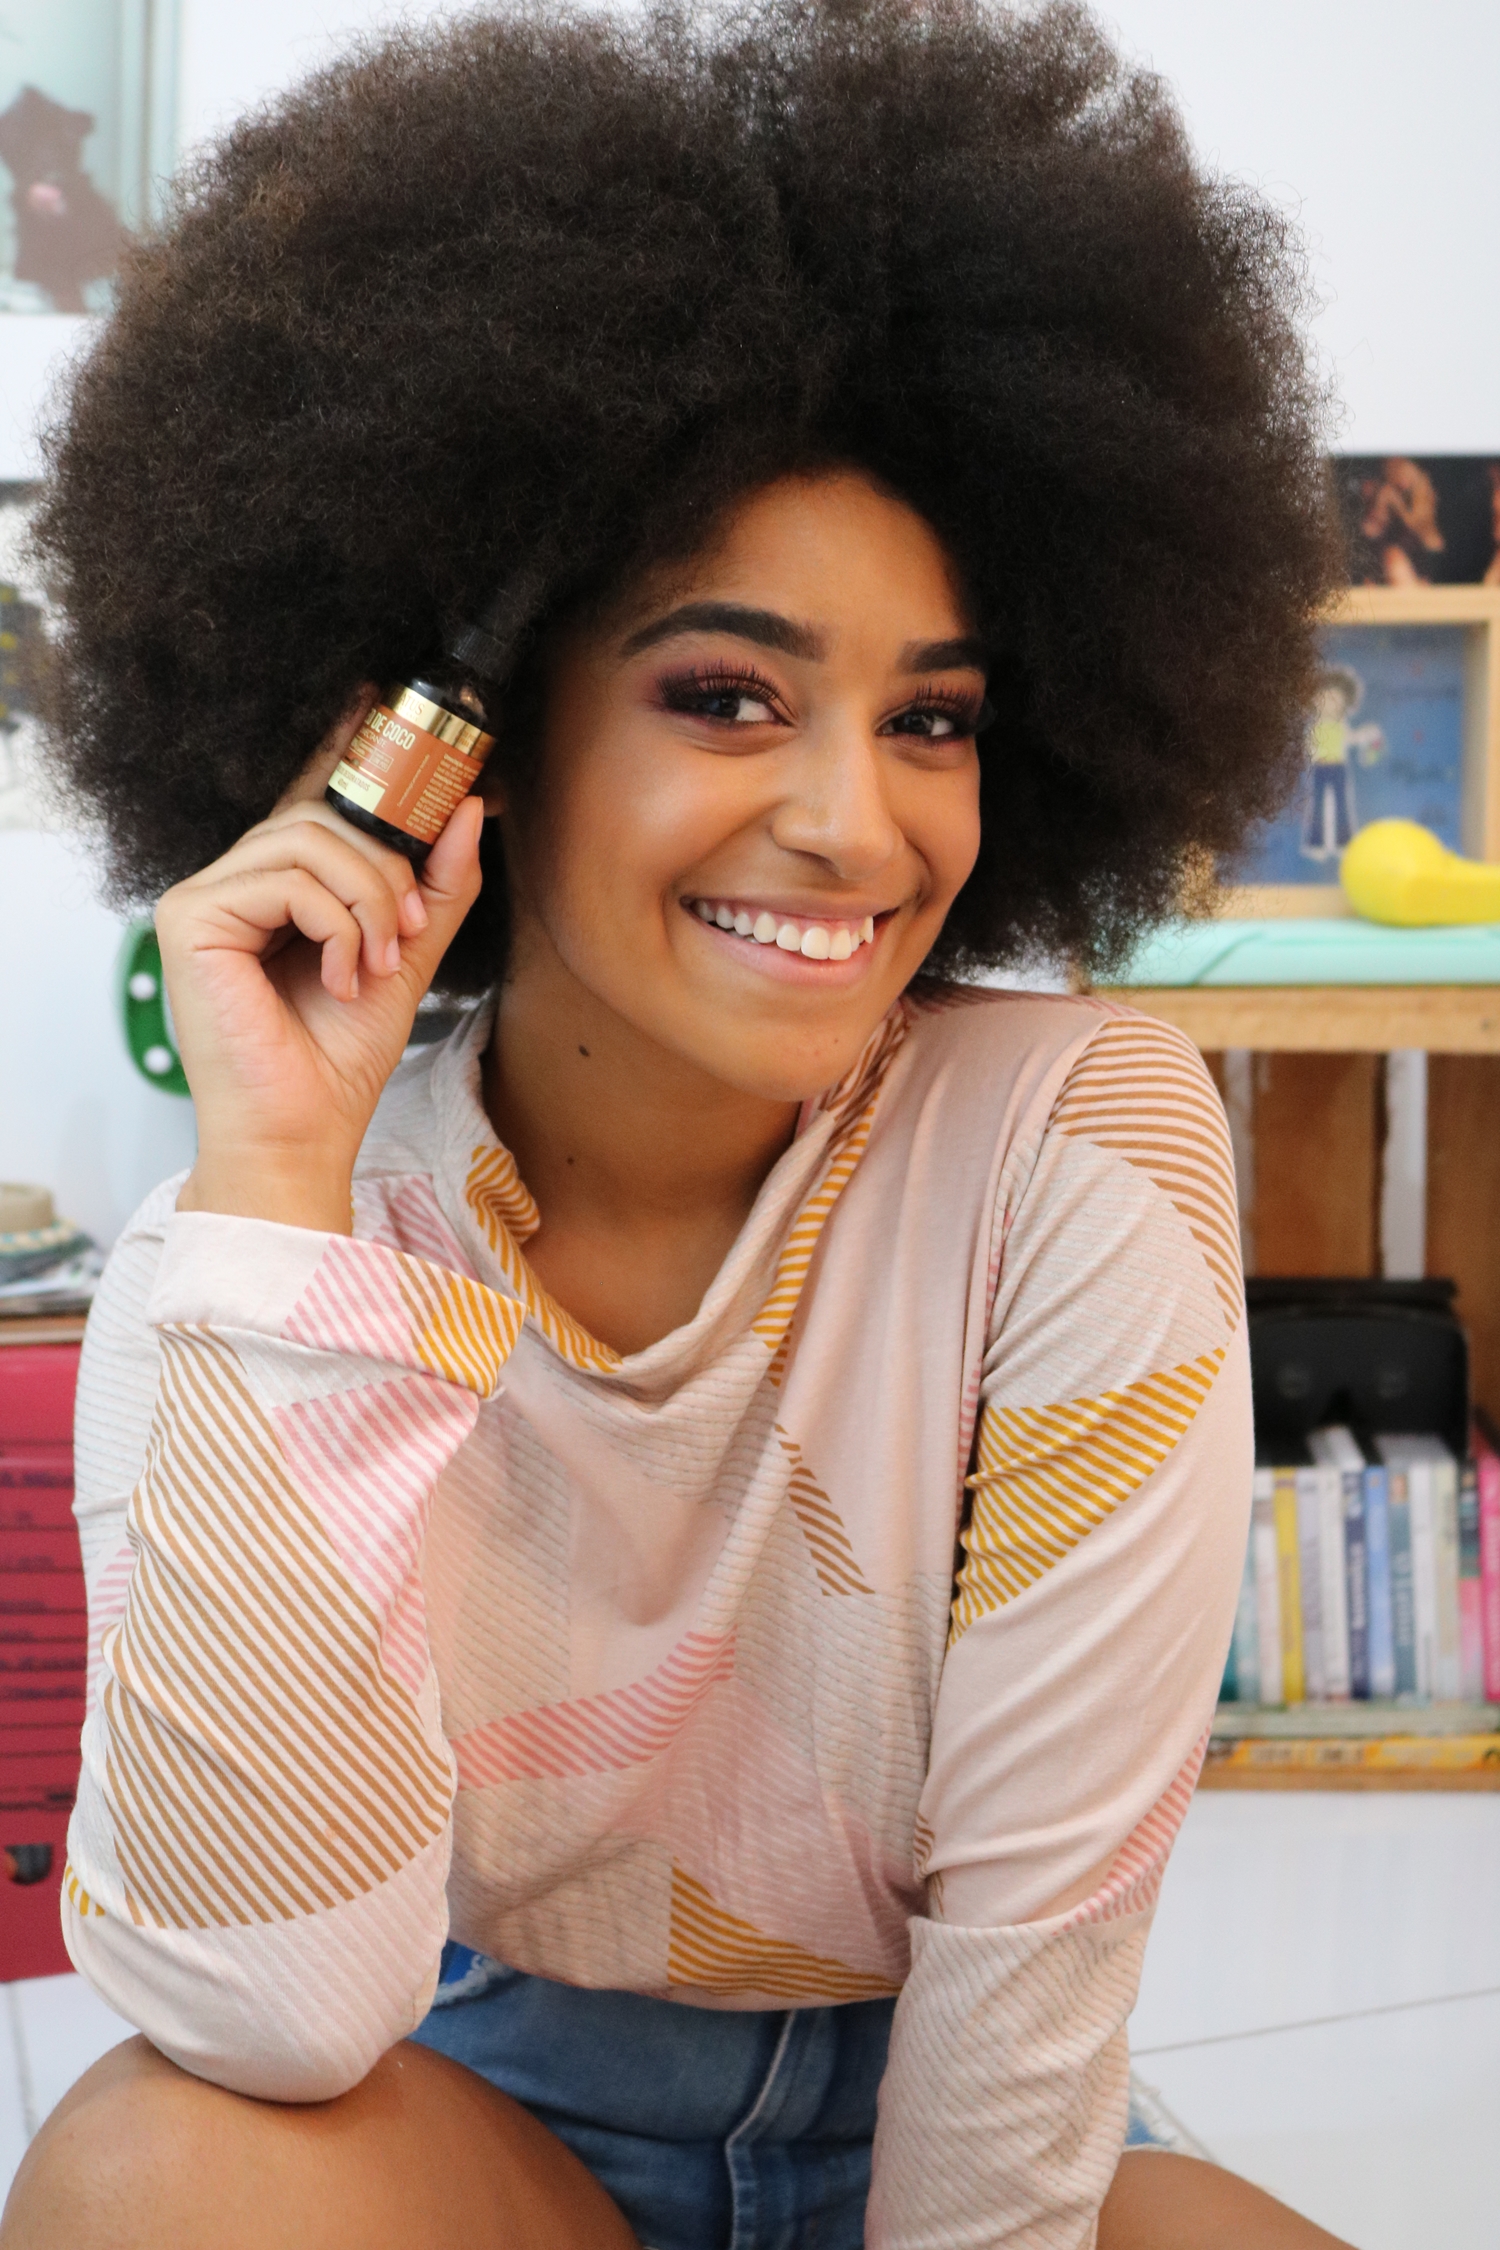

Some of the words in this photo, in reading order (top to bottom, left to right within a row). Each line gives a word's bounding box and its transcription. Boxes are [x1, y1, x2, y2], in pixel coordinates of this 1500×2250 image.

[399, 692, 425, 716] ATUS
[370, 711, 388, 733] DE
[382, 719, 416, 751] COCO
